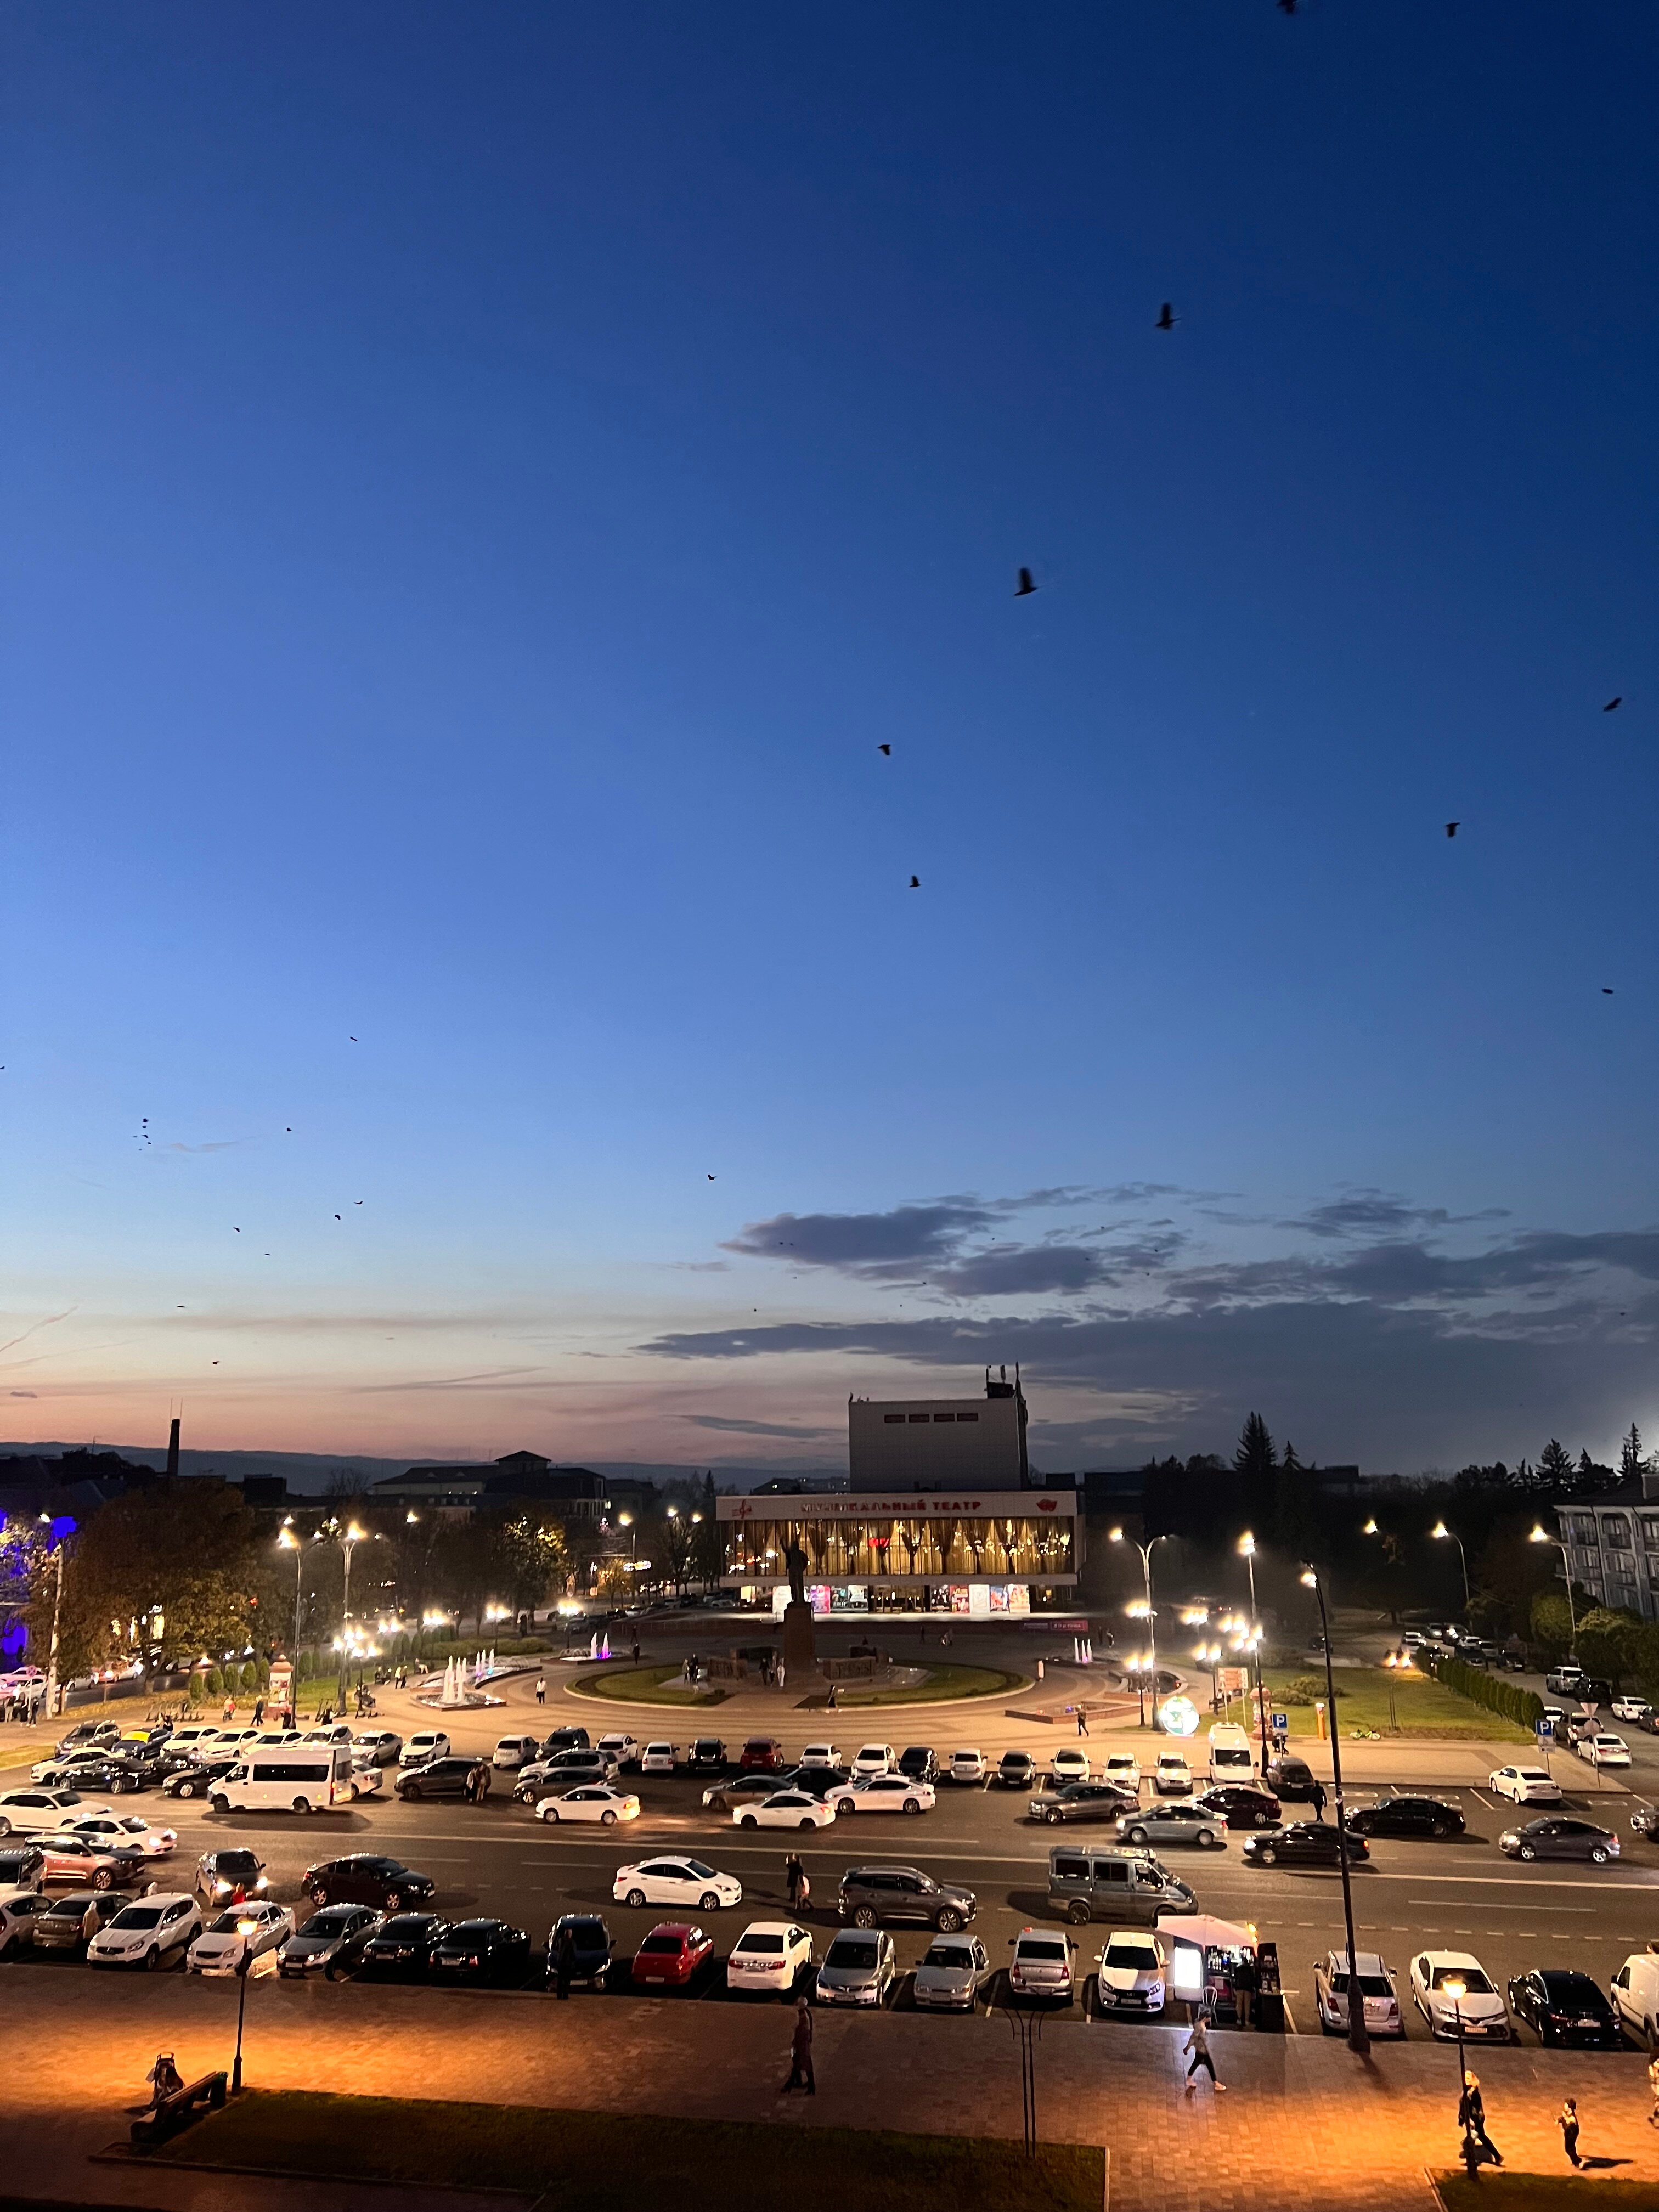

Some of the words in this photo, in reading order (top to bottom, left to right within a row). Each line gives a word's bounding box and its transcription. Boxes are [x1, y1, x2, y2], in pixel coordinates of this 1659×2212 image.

[932, 1501, 981, 1510] ТЕАТР
[1276, 1714, 1285, 1726] P
[1540, 1722, 1549, 1734] P
